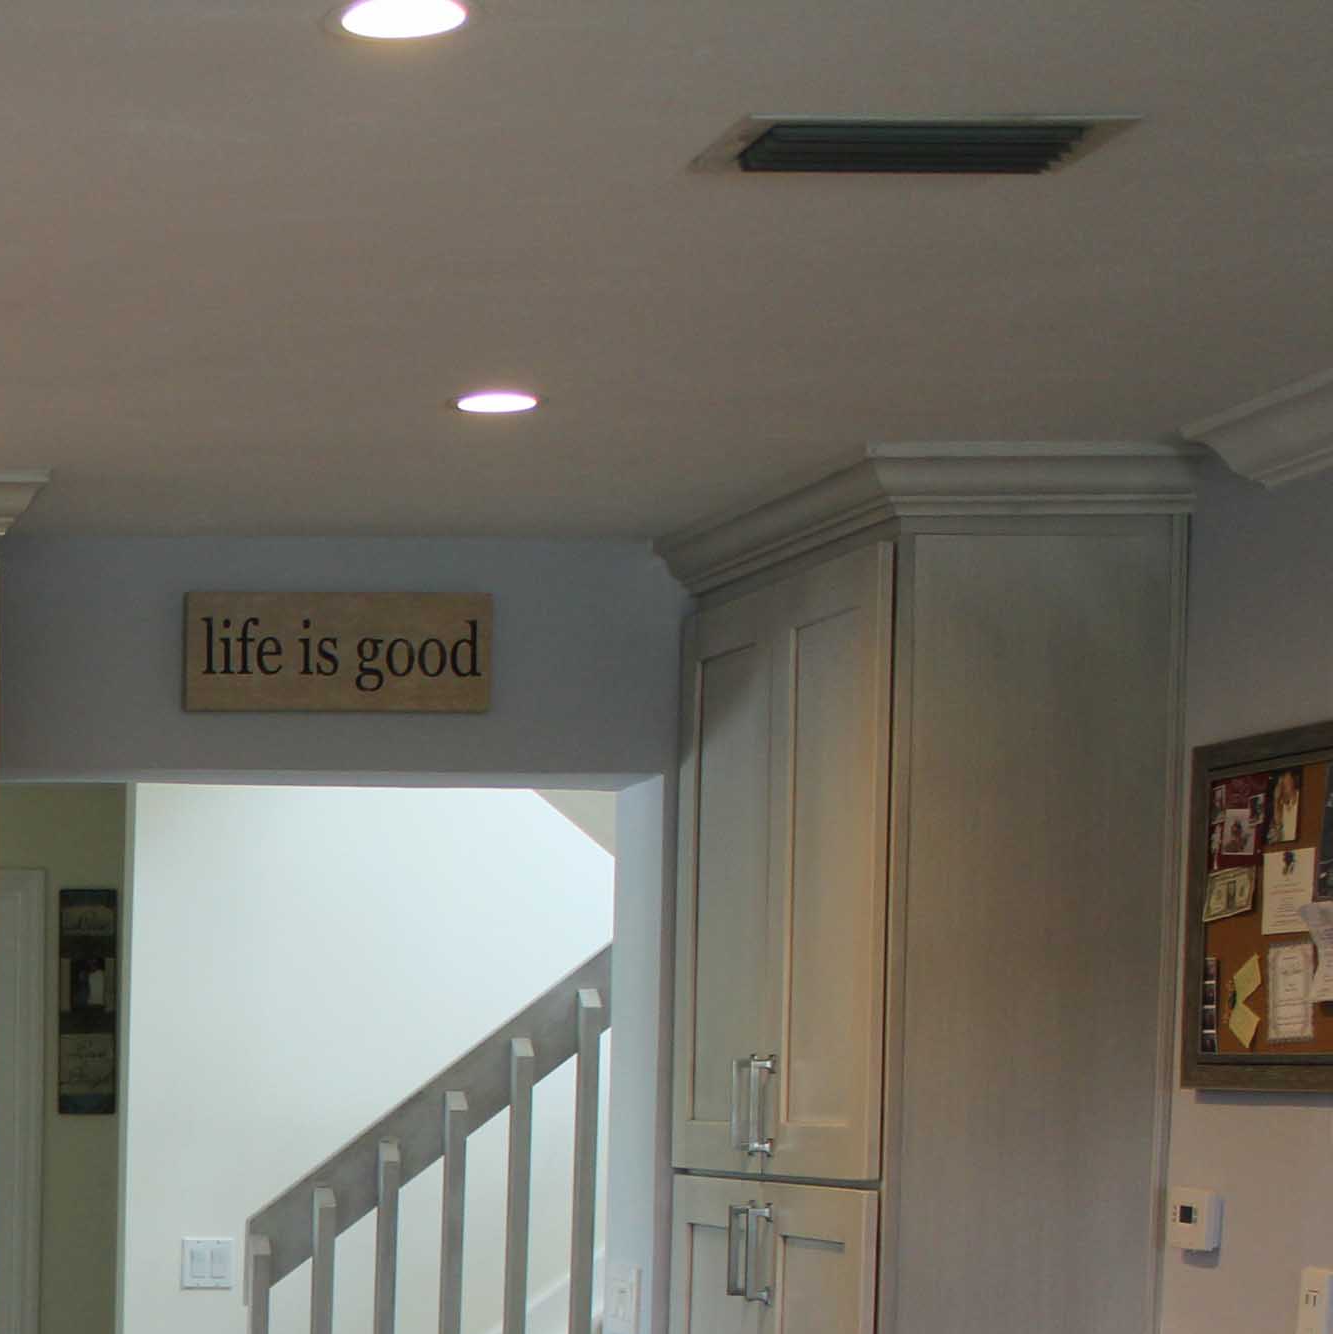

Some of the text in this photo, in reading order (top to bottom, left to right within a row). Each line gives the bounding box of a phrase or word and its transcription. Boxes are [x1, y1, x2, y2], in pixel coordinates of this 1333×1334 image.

[201, 616, 482, 692] life is good
